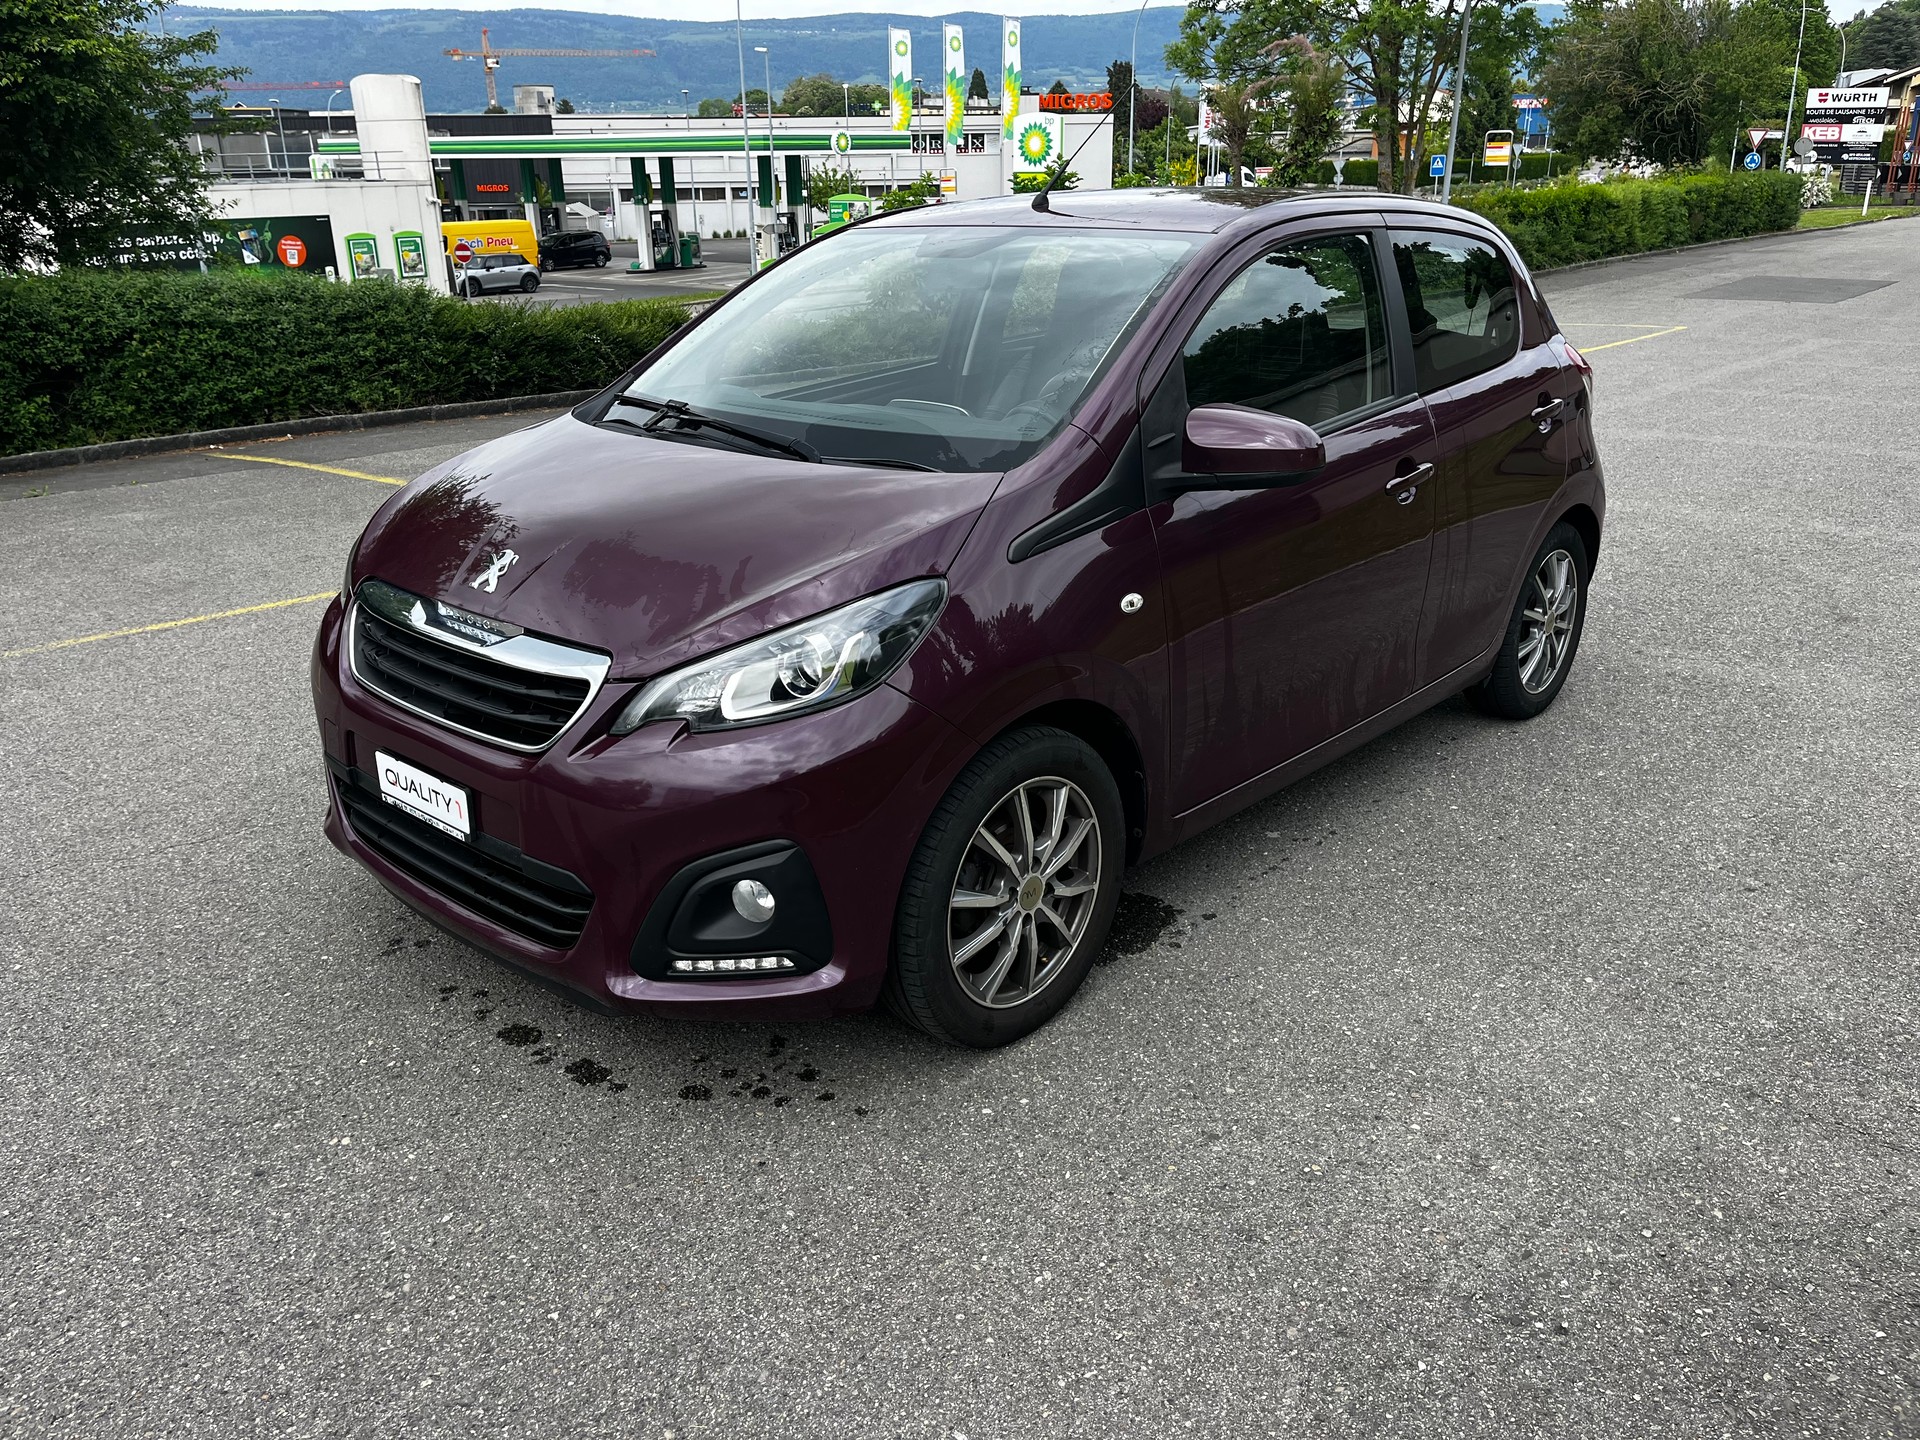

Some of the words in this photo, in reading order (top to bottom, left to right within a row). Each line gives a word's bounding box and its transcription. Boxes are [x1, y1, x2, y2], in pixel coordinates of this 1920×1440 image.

[1039, 92, 1113, 109] MIGROS
[1044, 116, 1055, 126] bp
[1803, 126, 1840, 140] KEB
[476, 184, 509, 192] MIGROS
[486, 237, 513, 247] Pneu
